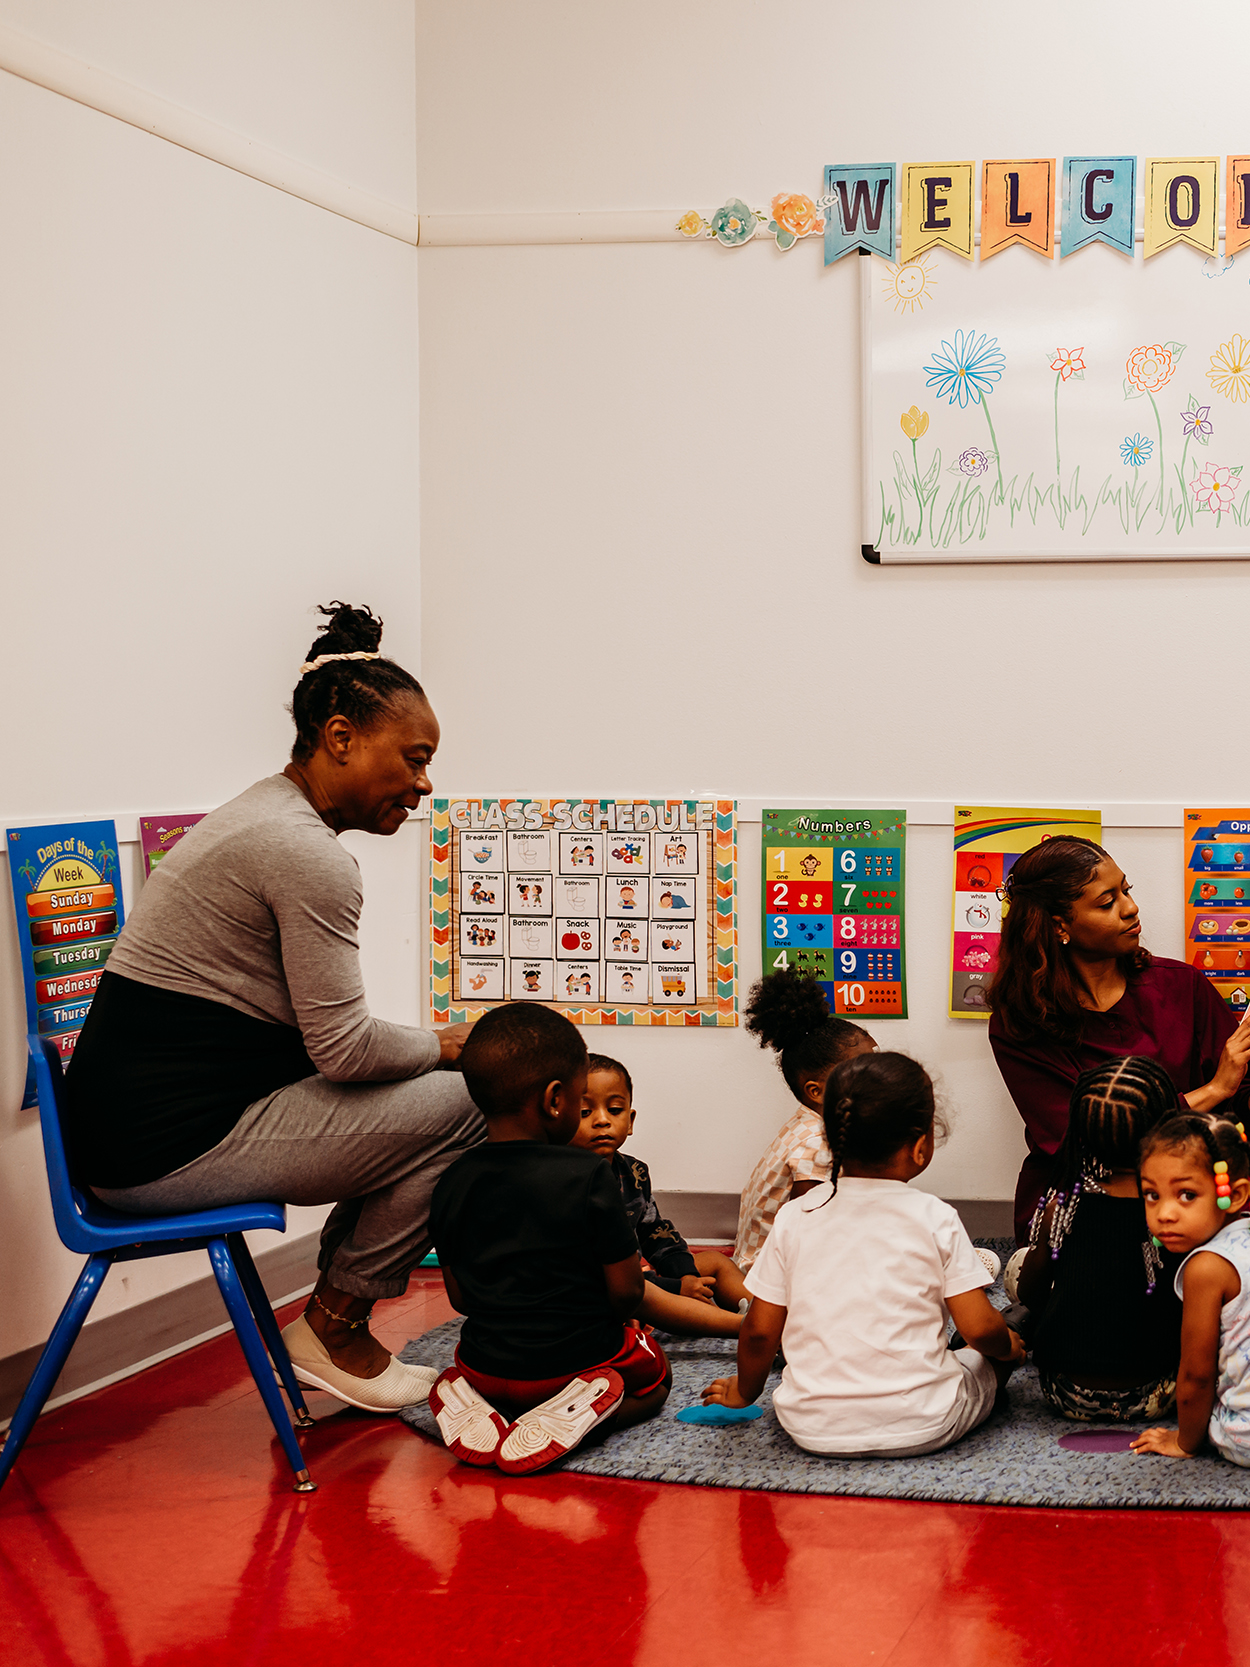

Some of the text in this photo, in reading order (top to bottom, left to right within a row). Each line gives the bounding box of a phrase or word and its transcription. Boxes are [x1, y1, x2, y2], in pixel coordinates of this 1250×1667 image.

[450, 801, 714, 833] CLASS SCHEDULE
[798, 817, 873, 833] Numbers
[159, 826, 183, 844] Seasons
[465, 833, 498, 841] Breakfast
[512, 832, 545, 840] Bathroom
[36, 837, 94, 864] Days of the
[774, 850, 785, 872] 1
[840, 850, 857, 873] 6
[53, 866, 84, 883] Week
[616, 878, 639, 887] Lunch
[50, 890, 94, 909] Sunday
[773, 883, 789, 906] 2
[840, 884, 857, 906] 7
[52, 918, 97, 936] Monday
[512, 919, 548, 927] Bathroom
[566, 919, 590, 928] Snack
[656, 923, 689, 931] Playground
[773, 916, 788, 939] 3
[840, 916, 856, 940] 8
[841, 940, 858, 948] eight
[53, 946, 101, 965] Tuesday
[772, 950, 789, 972] 4
[840, 950, 857, 973] 9
[657, 965, 690, 973] Dismissal
[837, 983, 865, 1006] 10
